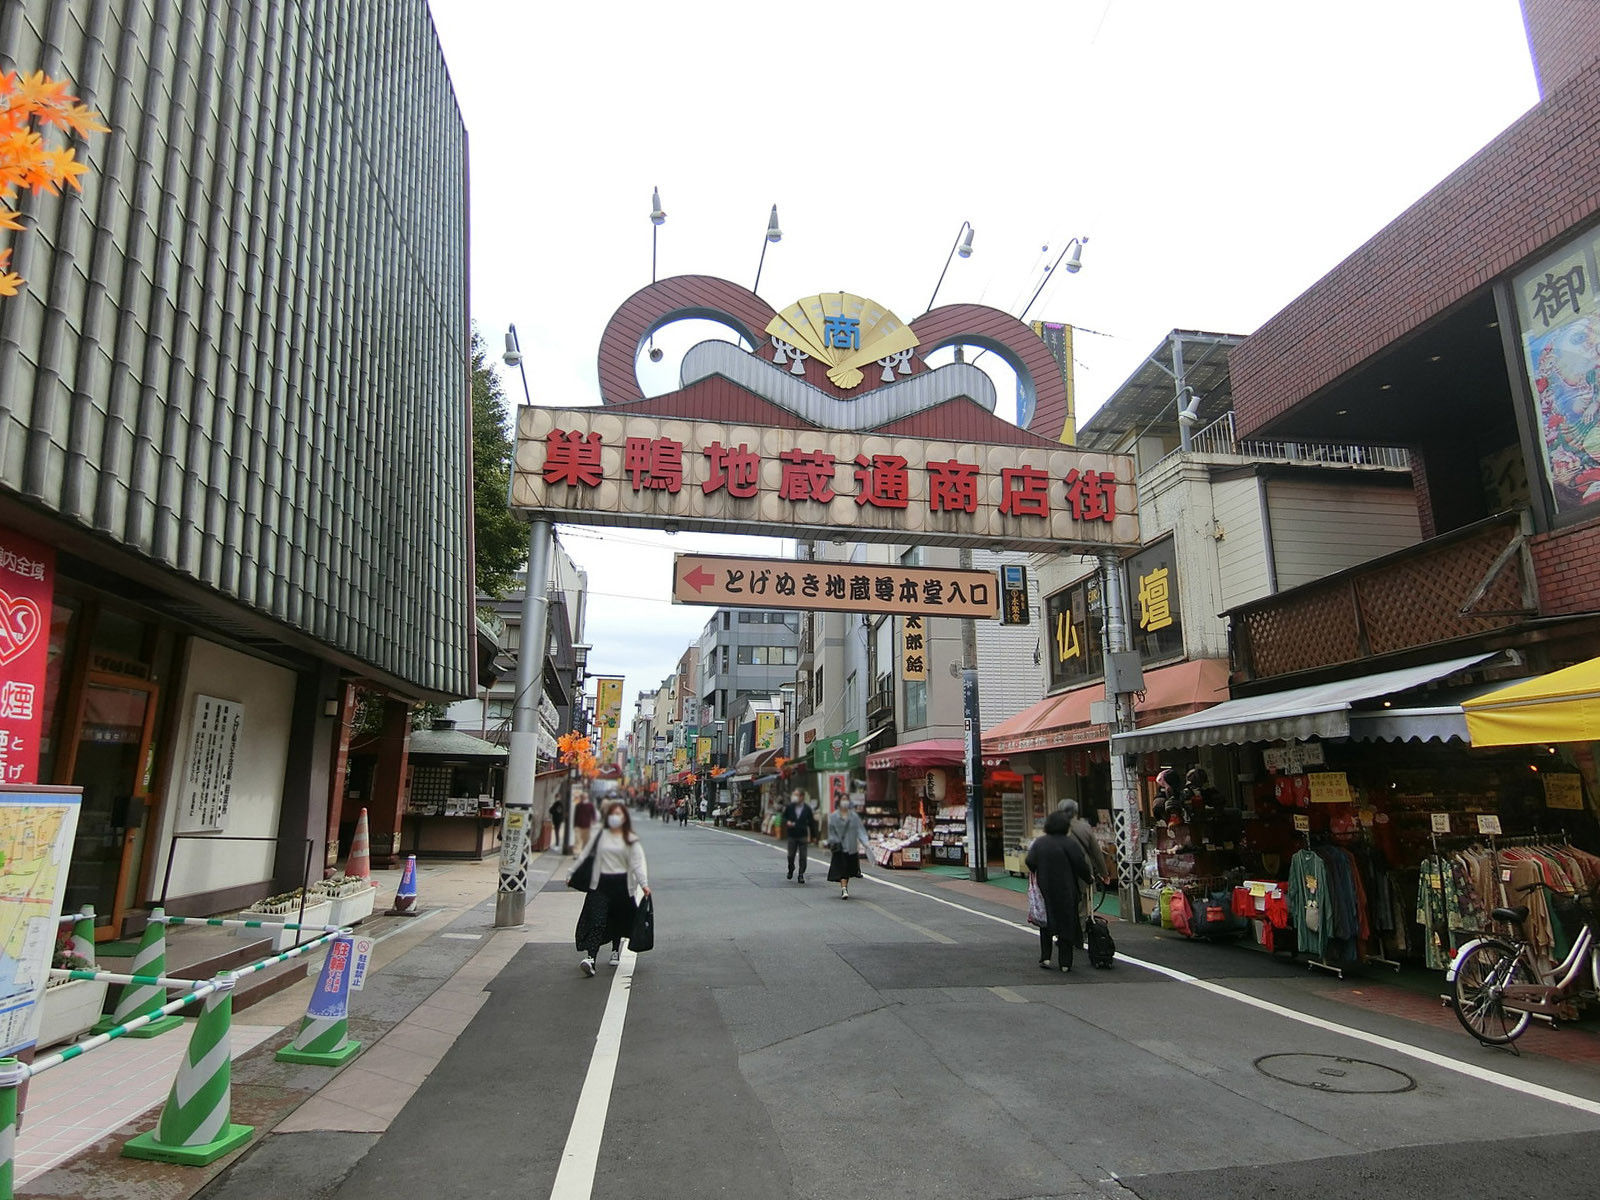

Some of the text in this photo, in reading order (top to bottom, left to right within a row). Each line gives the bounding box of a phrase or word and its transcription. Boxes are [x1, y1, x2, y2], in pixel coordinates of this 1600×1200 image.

[1532, 265, 1585, 328] 御
[824, 313, 860, 351] 商
[542, 428, 1116, 522] 巣鴨地蔵通商店街
[725, 569, 988, 605] とげぬき地蔵尊本堂入口
[1138, 568, 1173, 632] 壇
[1057, 609, 1080, 663] 仏
[1, 681, 35, 720] 煙
[330, 942, 350, 971] 駐輪
